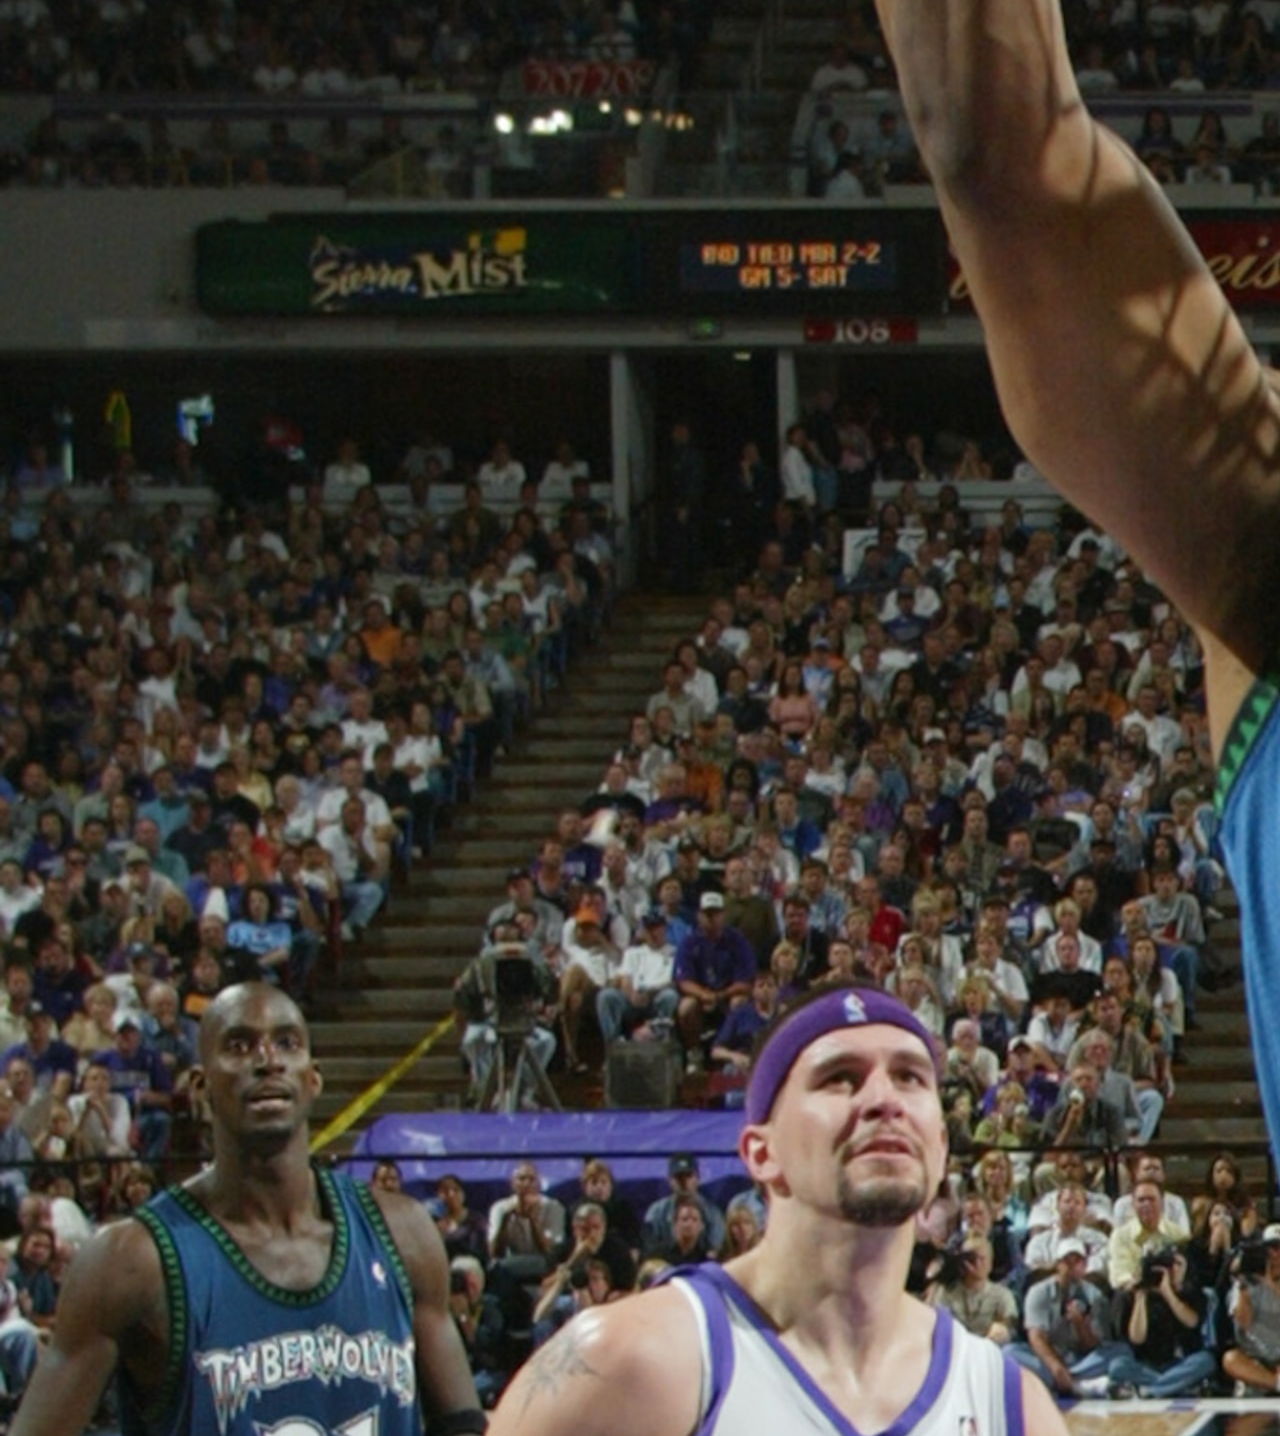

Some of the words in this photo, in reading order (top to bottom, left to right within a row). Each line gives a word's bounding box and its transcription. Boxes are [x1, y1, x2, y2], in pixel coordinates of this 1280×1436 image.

[842, 243, 881, 265] 2-2
[311, 259, 413, 305] Sierra
[413, 231, 529, 299] Mist
[807, 266, 849, 289] SAT
[834, 320, 891, 343] 108
